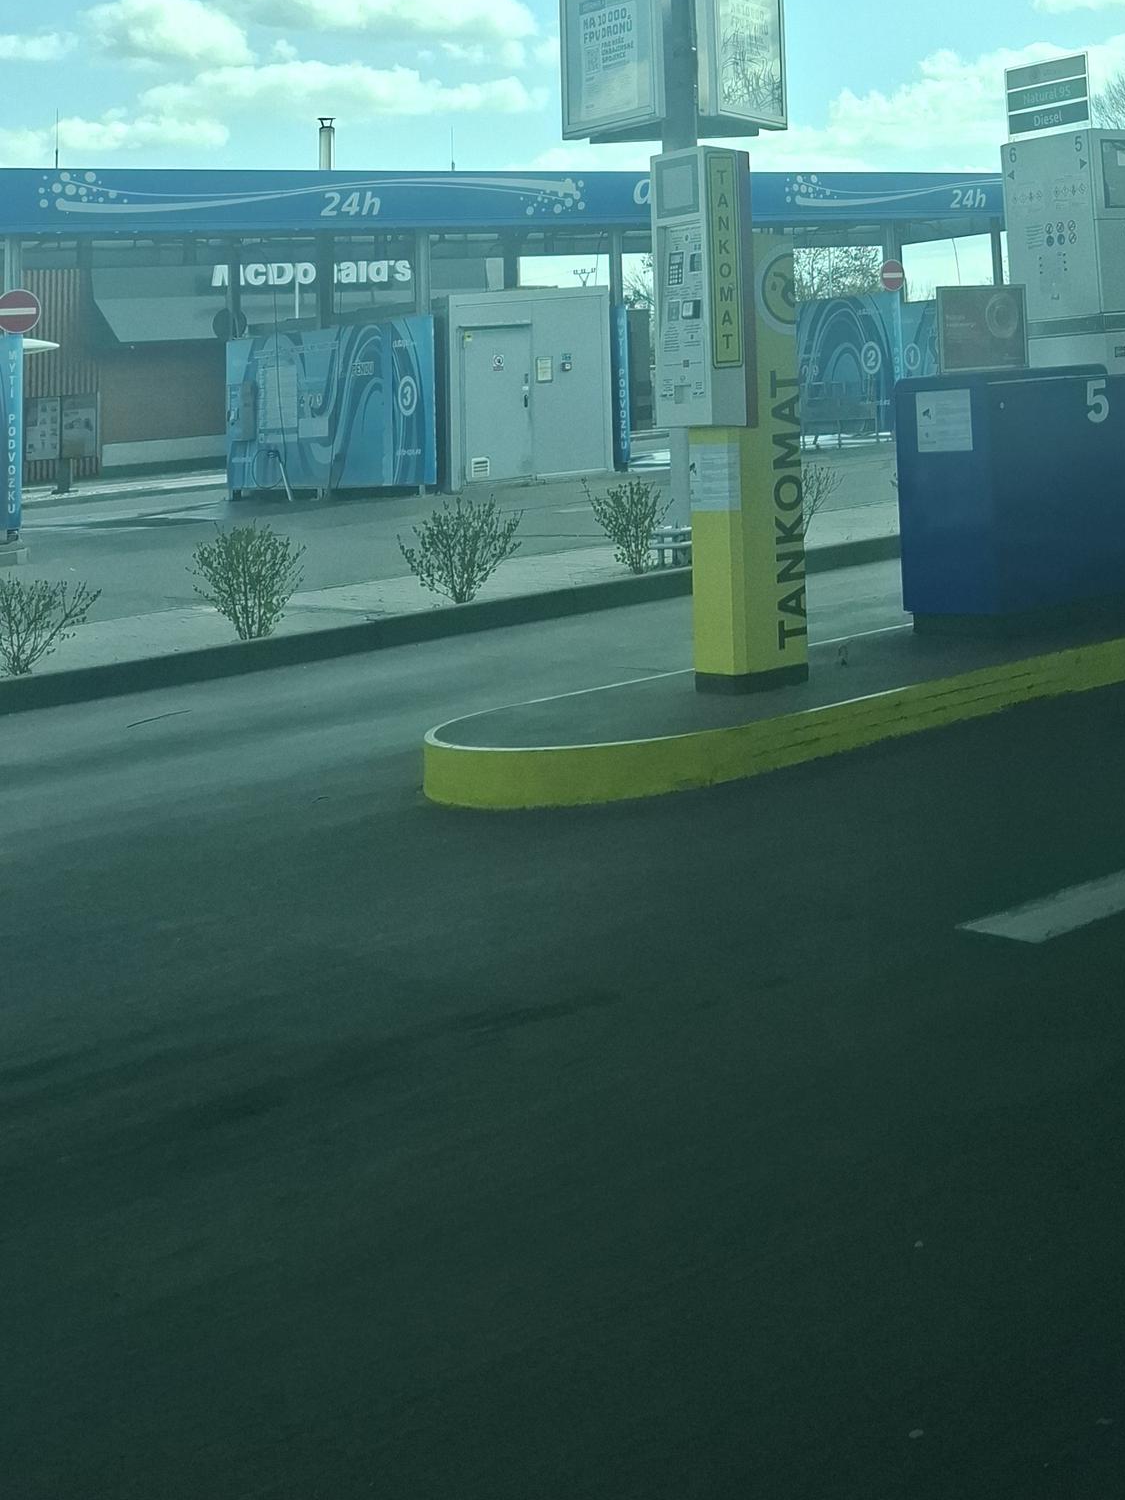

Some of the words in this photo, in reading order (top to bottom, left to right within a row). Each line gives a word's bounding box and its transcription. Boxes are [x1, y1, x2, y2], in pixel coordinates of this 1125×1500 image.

[1023, 87, 1057, 105] Natural
[1060, 85, 1071, 97] 95
[1033, 110, 1062, 127] Diesel
[1074, 135, 1083, 152] 5
[1009, 147, 1017, 163] 6
[320, 191, 381, 217] 24h
[950, 188, 986, 209] 24h
[716, 169, 734, 350] TANKOMAT
[211, 260, 412, 287] McDoald's
[867, 350, 876, 367] 2
[403, 386, 412, 408] 3
[1086, 379, 1110, 423] 5
[7, 414, 16, 514] PODVOZKU
[770, 370, 807, 651] TANKOMAT
